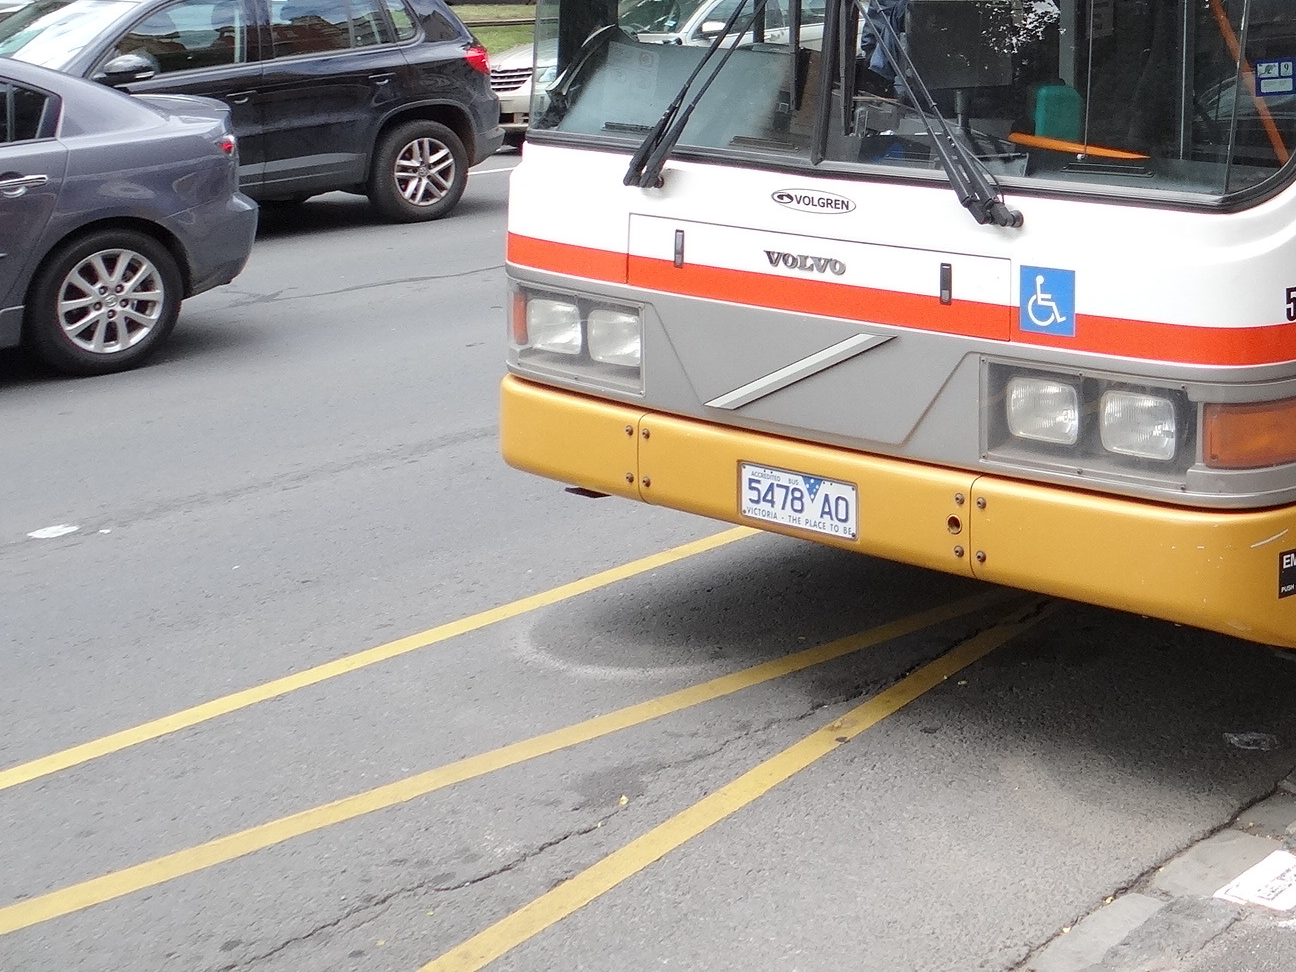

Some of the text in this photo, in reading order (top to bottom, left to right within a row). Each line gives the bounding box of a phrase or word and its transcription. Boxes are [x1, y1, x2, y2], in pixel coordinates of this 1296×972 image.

[794, 194, 850, 211] VOLGREN
[763, 249, 847, 276] VOLVO
[750, 470, 800, 486] ACCREDITED BUS
[747, 477, 850, 524] 5478 AO
[746, 506, 778, 520] VICTORIA
[788, 514, 802, 525] THE
[804, 518, 827, 531] PLACE
[830, 523, 840, 534] TO
[843, 526, 853, 536] BE
[1280, 583, 1295, 593] PUSH
